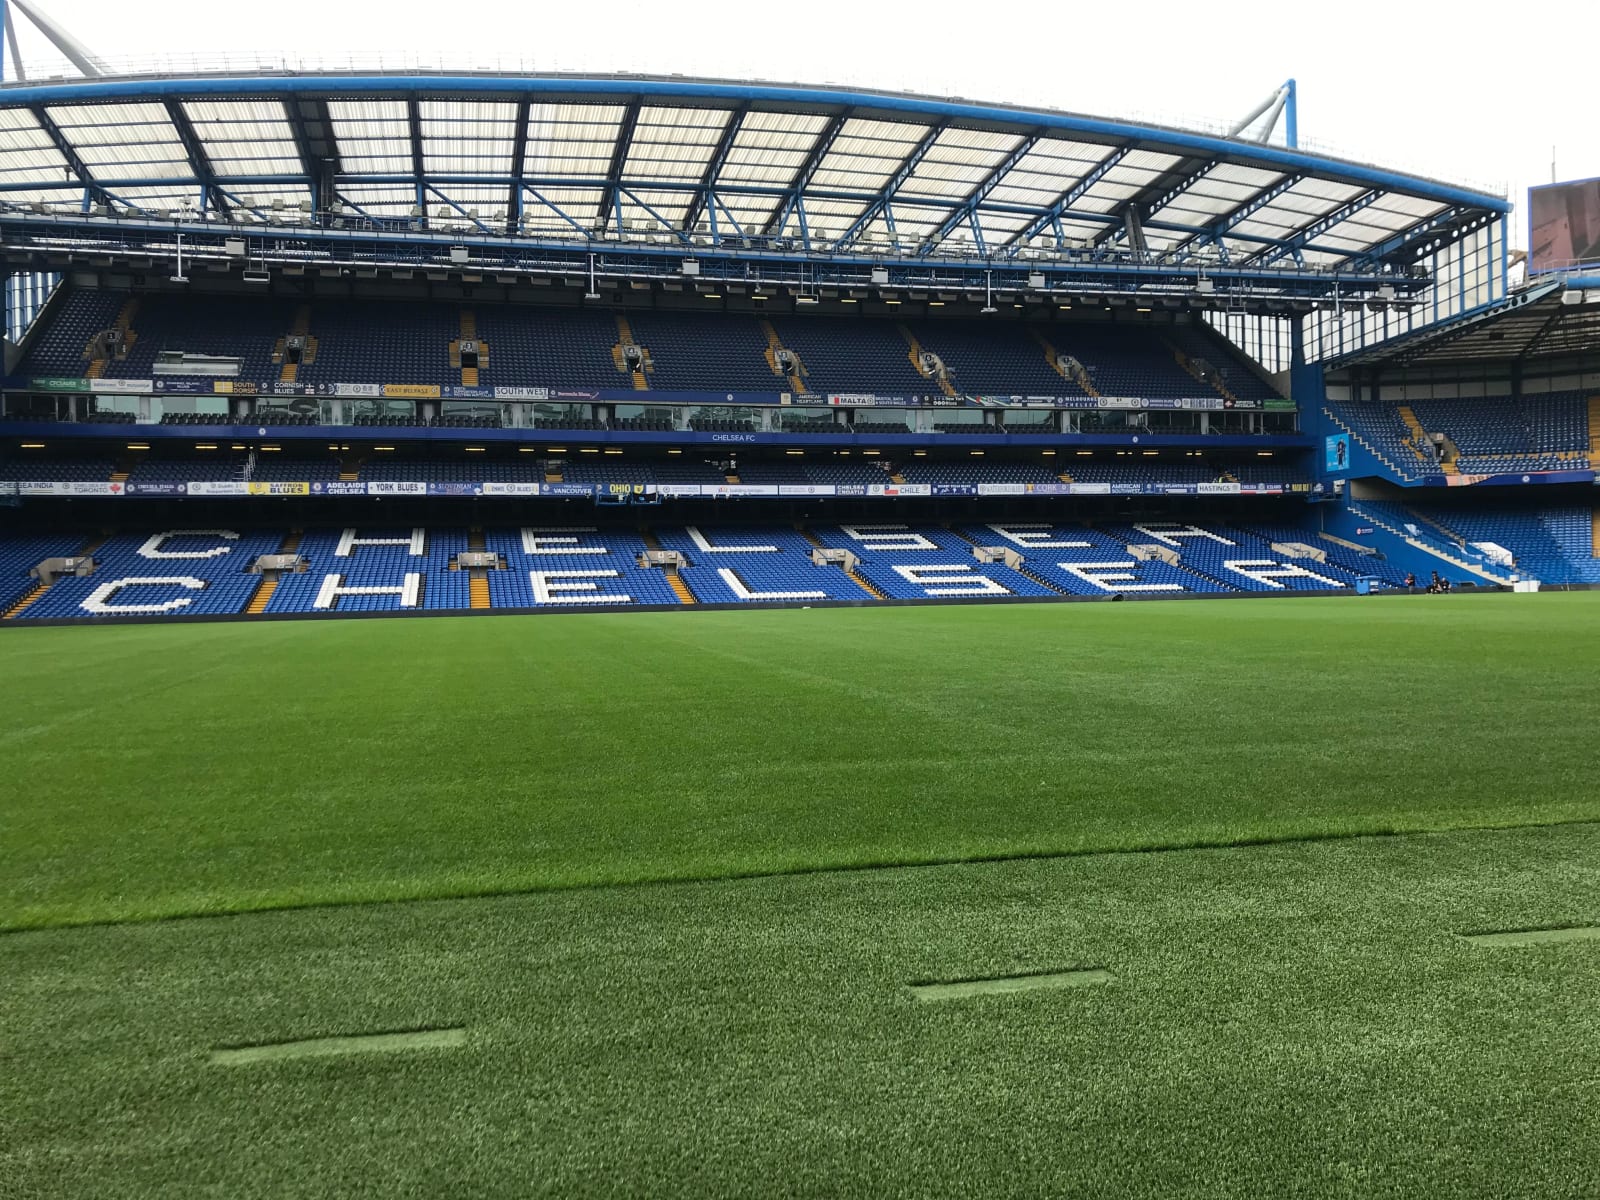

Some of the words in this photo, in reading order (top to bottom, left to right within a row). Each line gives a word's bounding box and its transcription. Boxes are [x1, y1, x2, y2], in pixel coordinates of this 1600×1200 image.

[495, 387, 524, 395] SOUTH
[375, 483, 394, 491] YORK
[397, 483, 419, 492] BLUES
[609, 483, 631, 493] OHIO
[79, 557, 1346, 614] CHELSEA
